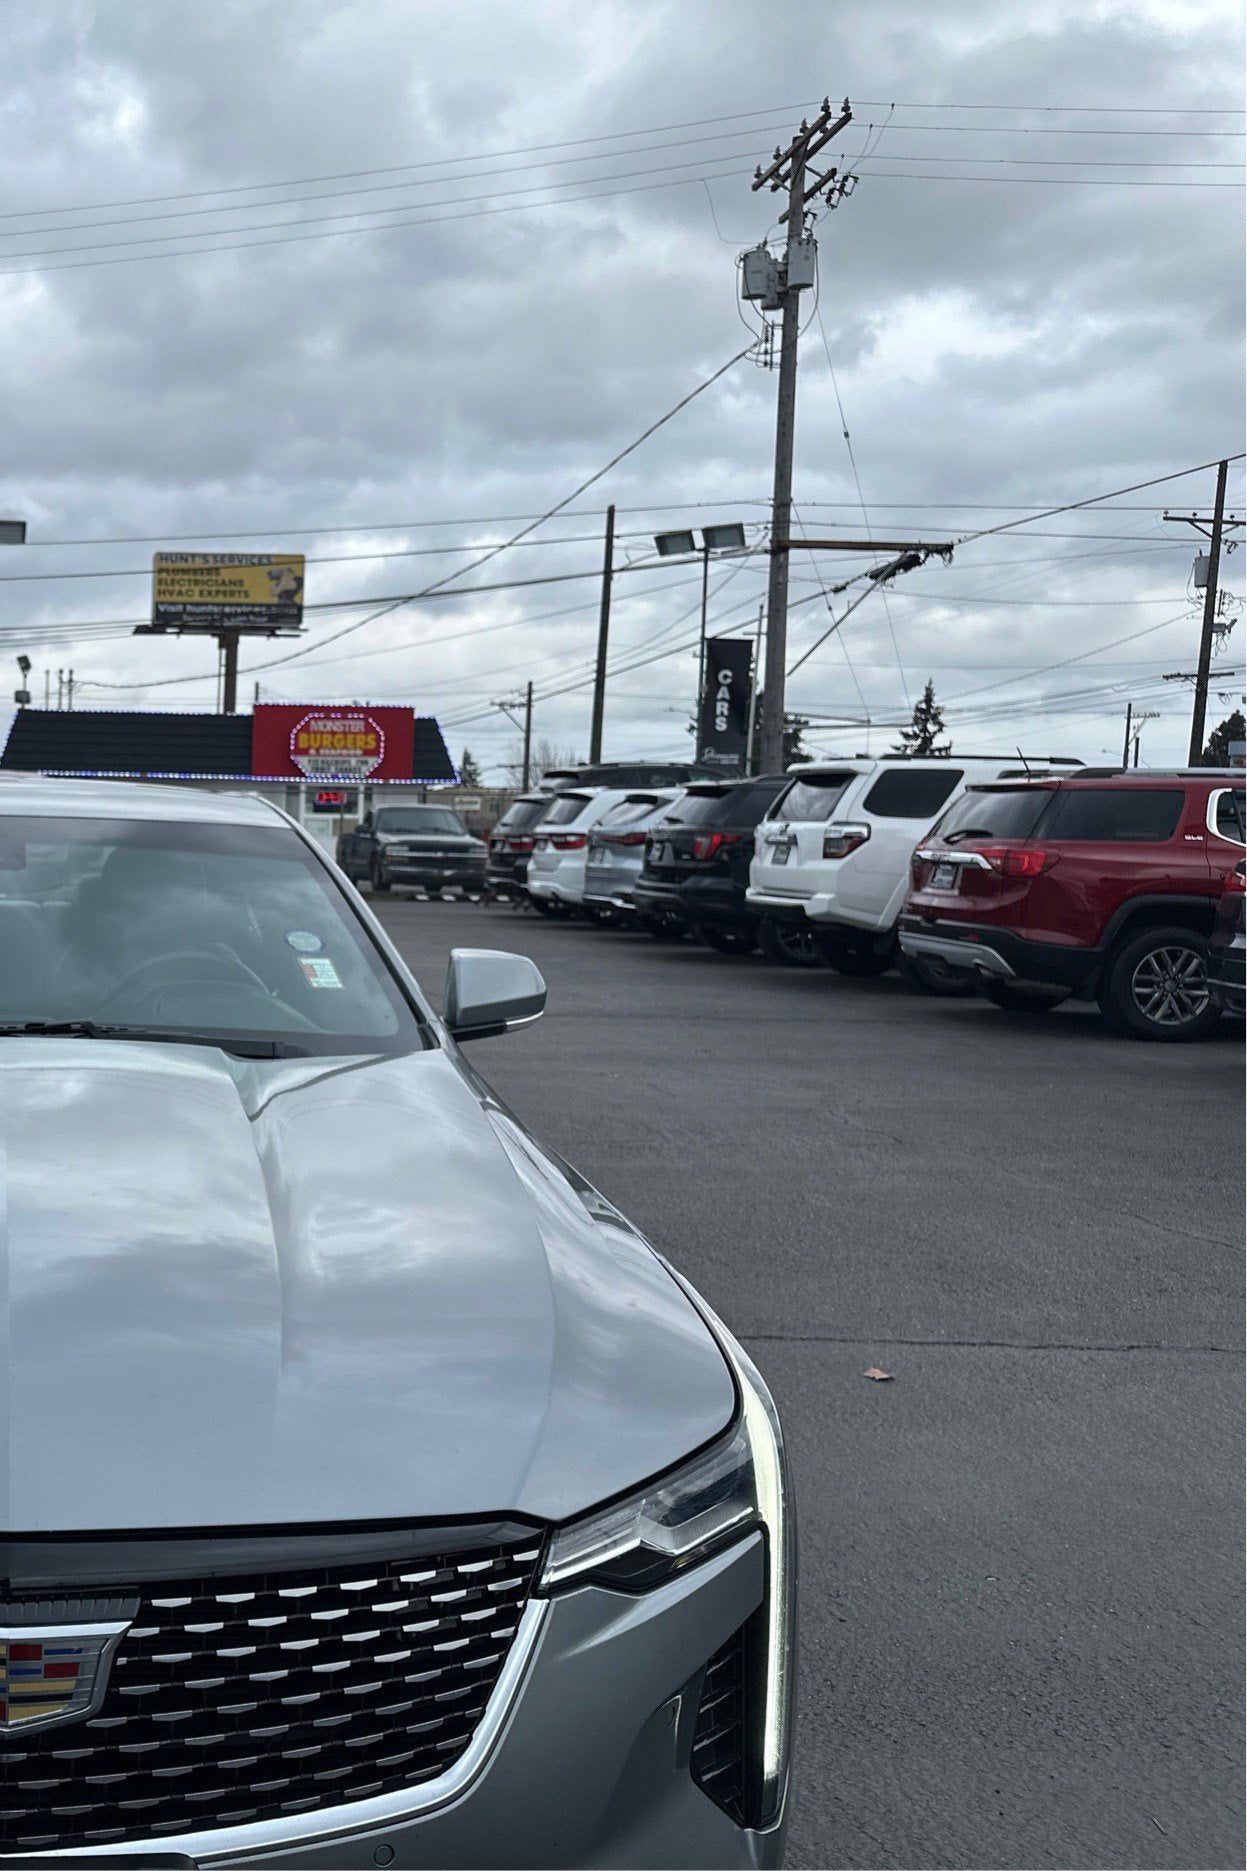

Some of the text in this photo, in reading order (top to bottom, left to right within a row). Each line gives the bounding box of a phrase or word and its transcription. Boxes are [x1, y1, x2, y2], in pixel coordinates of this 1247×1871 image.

[158, 554, 274, 566] HUNT'S SERVICES
[157, 578, 245, 588] ELECTRICIANS
[157, 588, 251, 599] HVAC EXPERTS
[714, 668, 733, 732] CARS
[309, 719, 365, 732] MONSTER
[298, 733, 377, 750] BURGERS
